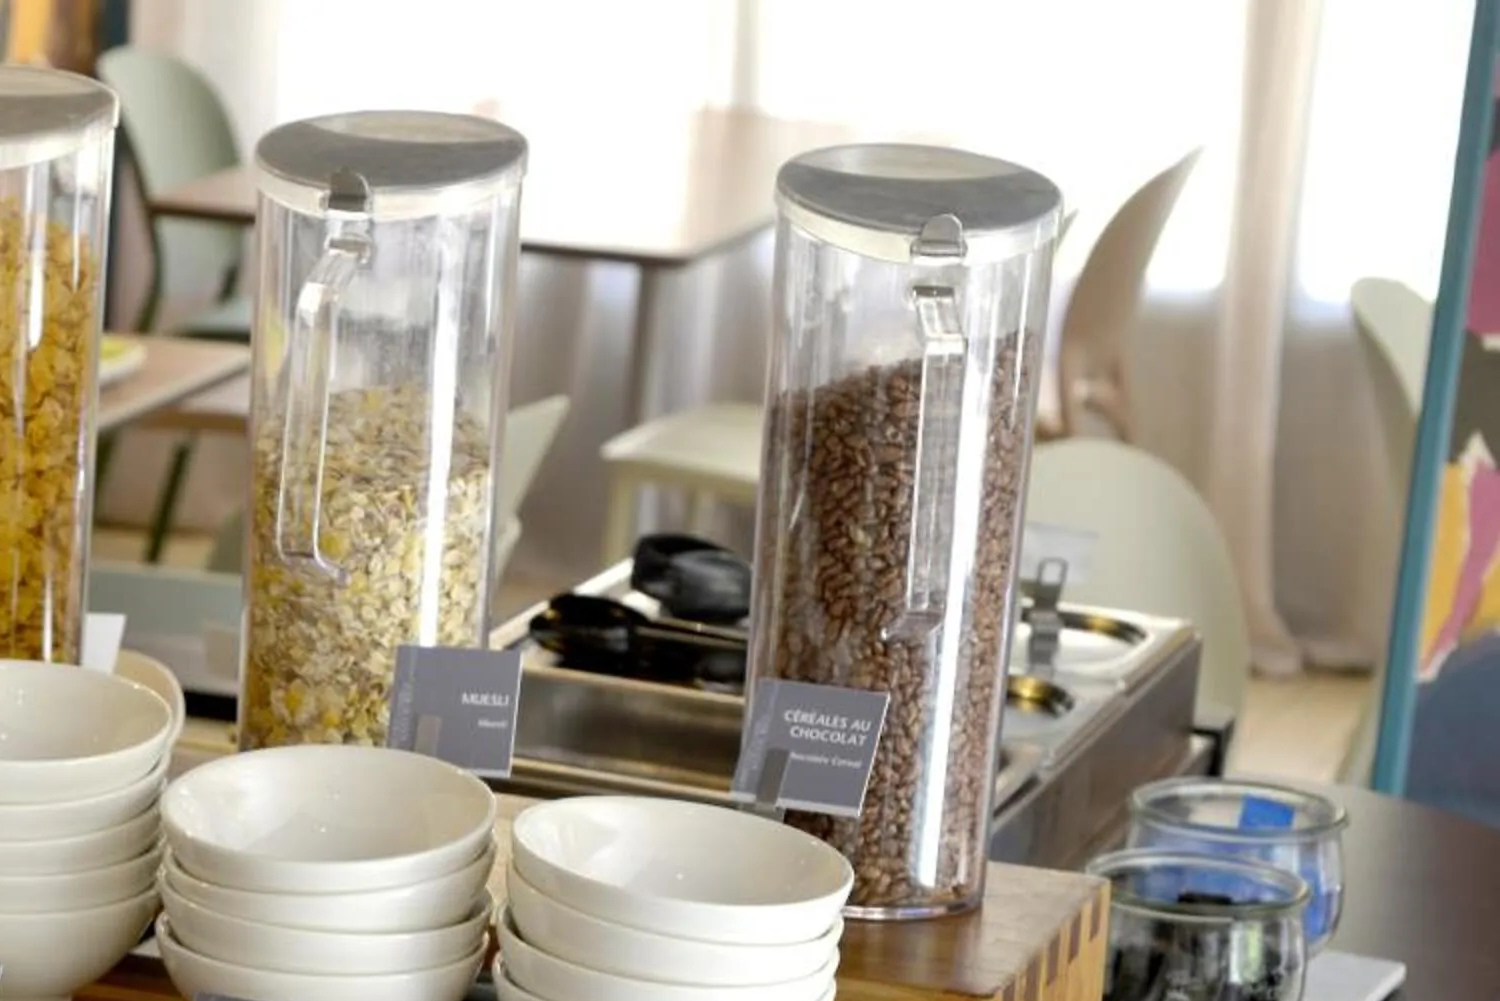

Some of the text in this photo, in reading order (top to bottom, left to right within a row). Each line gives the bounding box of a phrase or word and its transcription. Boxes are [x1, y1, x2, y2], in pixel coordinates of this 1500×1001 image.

[784, 708, 871, 732] CÉRÉALES AU
[790, 726, 867, 746] CHOCOLAT
